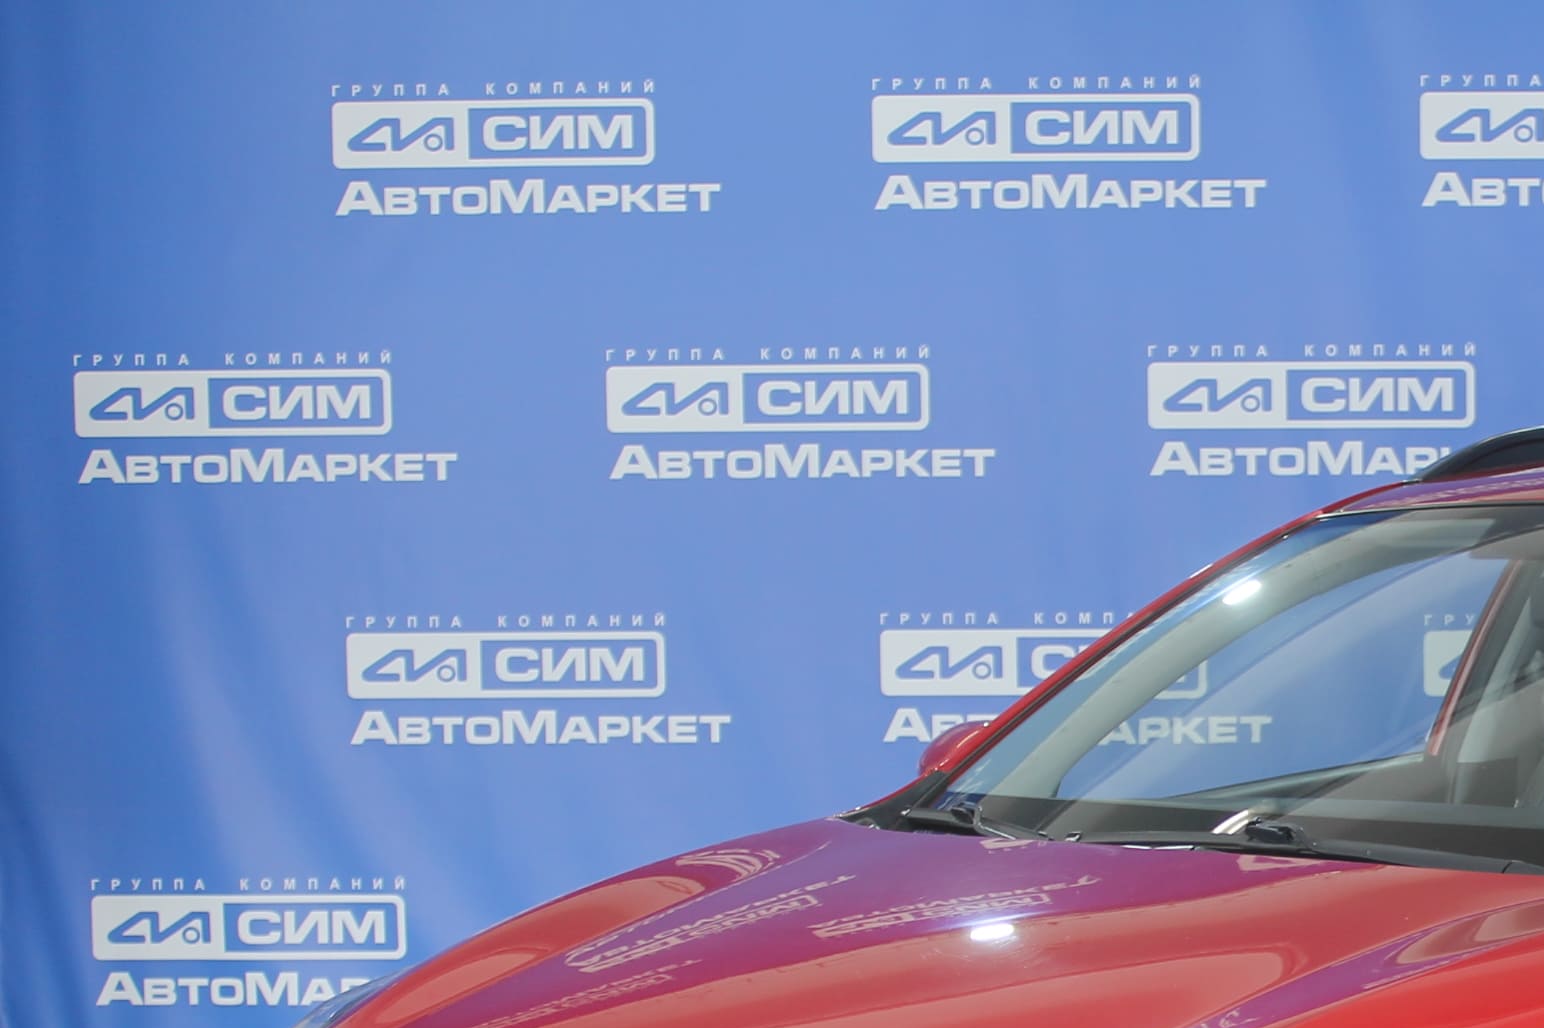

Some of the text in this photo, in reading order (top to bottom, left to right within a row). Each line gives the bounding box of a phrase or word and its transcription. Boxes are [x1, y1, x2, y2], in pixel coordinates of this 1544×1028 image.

[332, 79, 654, 97] ГРУППА КОМПАНИЙ
[872, 75, 1199, 91] ГРУППА КОМПАНИЙ
[1420, 74, 1541, 88] ГРУППА
[483, 114, 633, 150] СИМ
[1026, 110, 1178, 145] СИМ
[74, 350, 391, 367] ГРУППА КОМПАНИЙ
[606, 345, 929, 361] ГРУППА КОМПАНИЙ
[1148, 342, 1475, 358] ГРУППА КОМПАНИЙ
[223, 385, 370, 419] СИМ
[758, 380, 907, 415] СИМ
[1301, 377, 1453, 412] СИМ
[346, 612, 666, 628] ГРУППА КОМПАНИЙ
[880, 611, 998, 626] ГРУППА
[495, 647, 644, 681] СИМ
[91, 875, 405, 891] ГРУППА КОМПАНИЙ
[238, 910, 385, 944] СИМ
